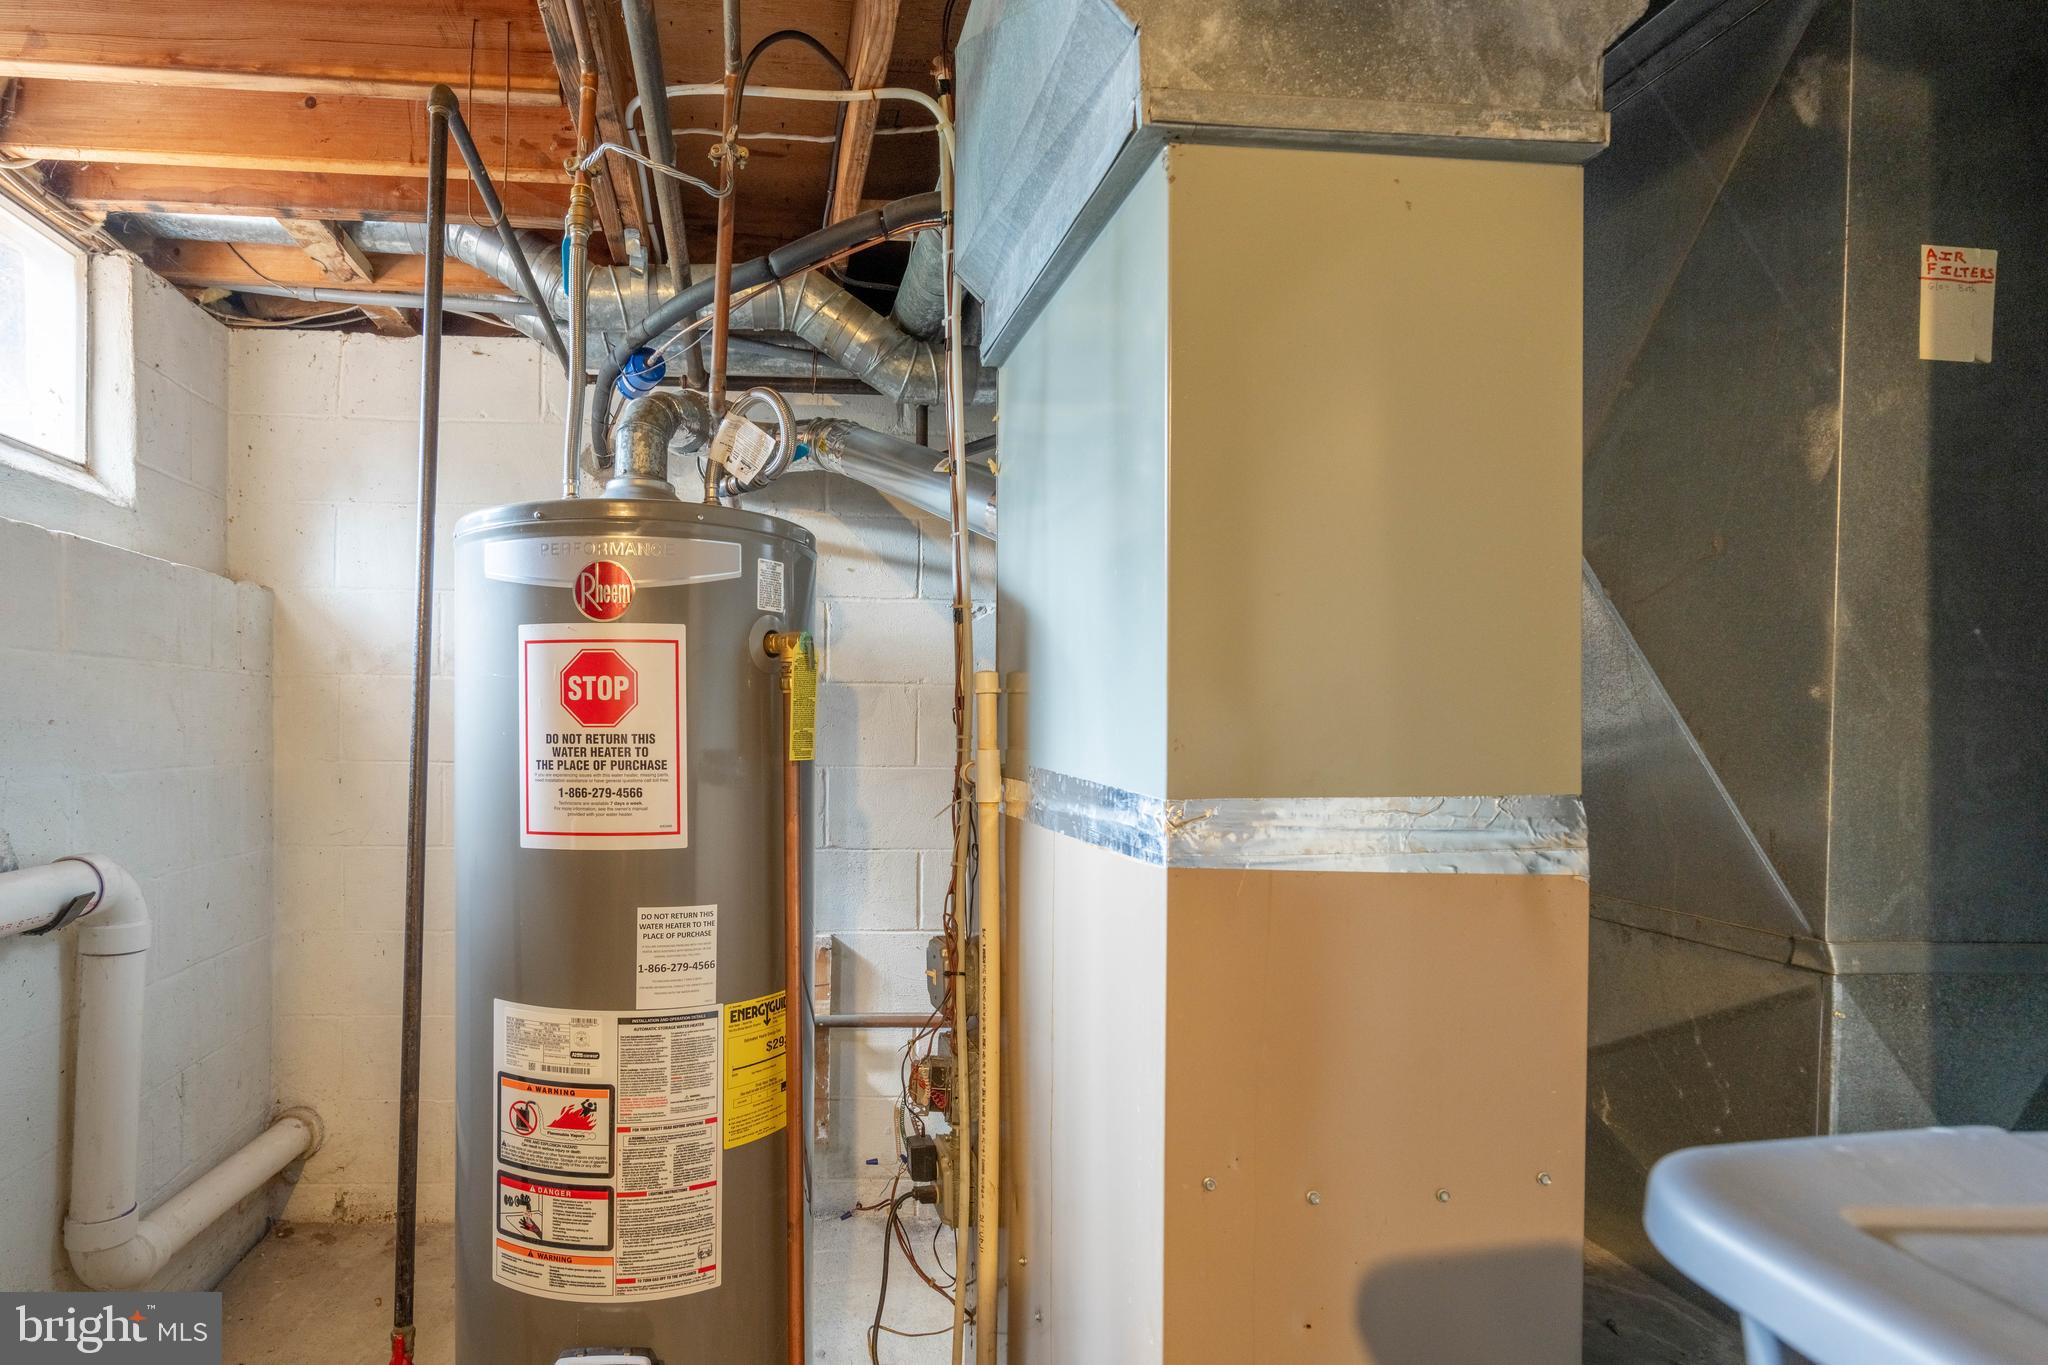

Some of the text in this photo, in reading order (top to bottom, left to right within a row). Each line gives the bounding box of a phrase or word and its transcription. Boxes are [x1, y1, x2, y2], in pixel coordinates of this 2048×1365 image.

[1926, 248, 1966, 263] AIR
[1928, 263, 1994, 279] FILTERS
[540, 542, 675, 556] PERFORMANCE
[581, 562, 631, 612] Rheem
[568, 675, 629, 701] STOP
[546, 733, 656, 744] DO NOT RETURN THIS
[552, 746, 648, 757] WATER HEATER TO
[536, 759, 668, 770] THE PLACE OF PURCHASE
[558, 787, 643, 798] 1-866-279-4566
[677, 930, 712, 938] PURCHASE
[638, 960, 716, 973] 1-866-279-4566
[730, 996, 786, 1024] ENERGYGUI
[766, 1036, 786, 1052] $29
[535, 1086, 576, 1097] WARNING
[537, 1187, 572, 1197] DANGER
[537, 1252, 573, 1264] WARNING
